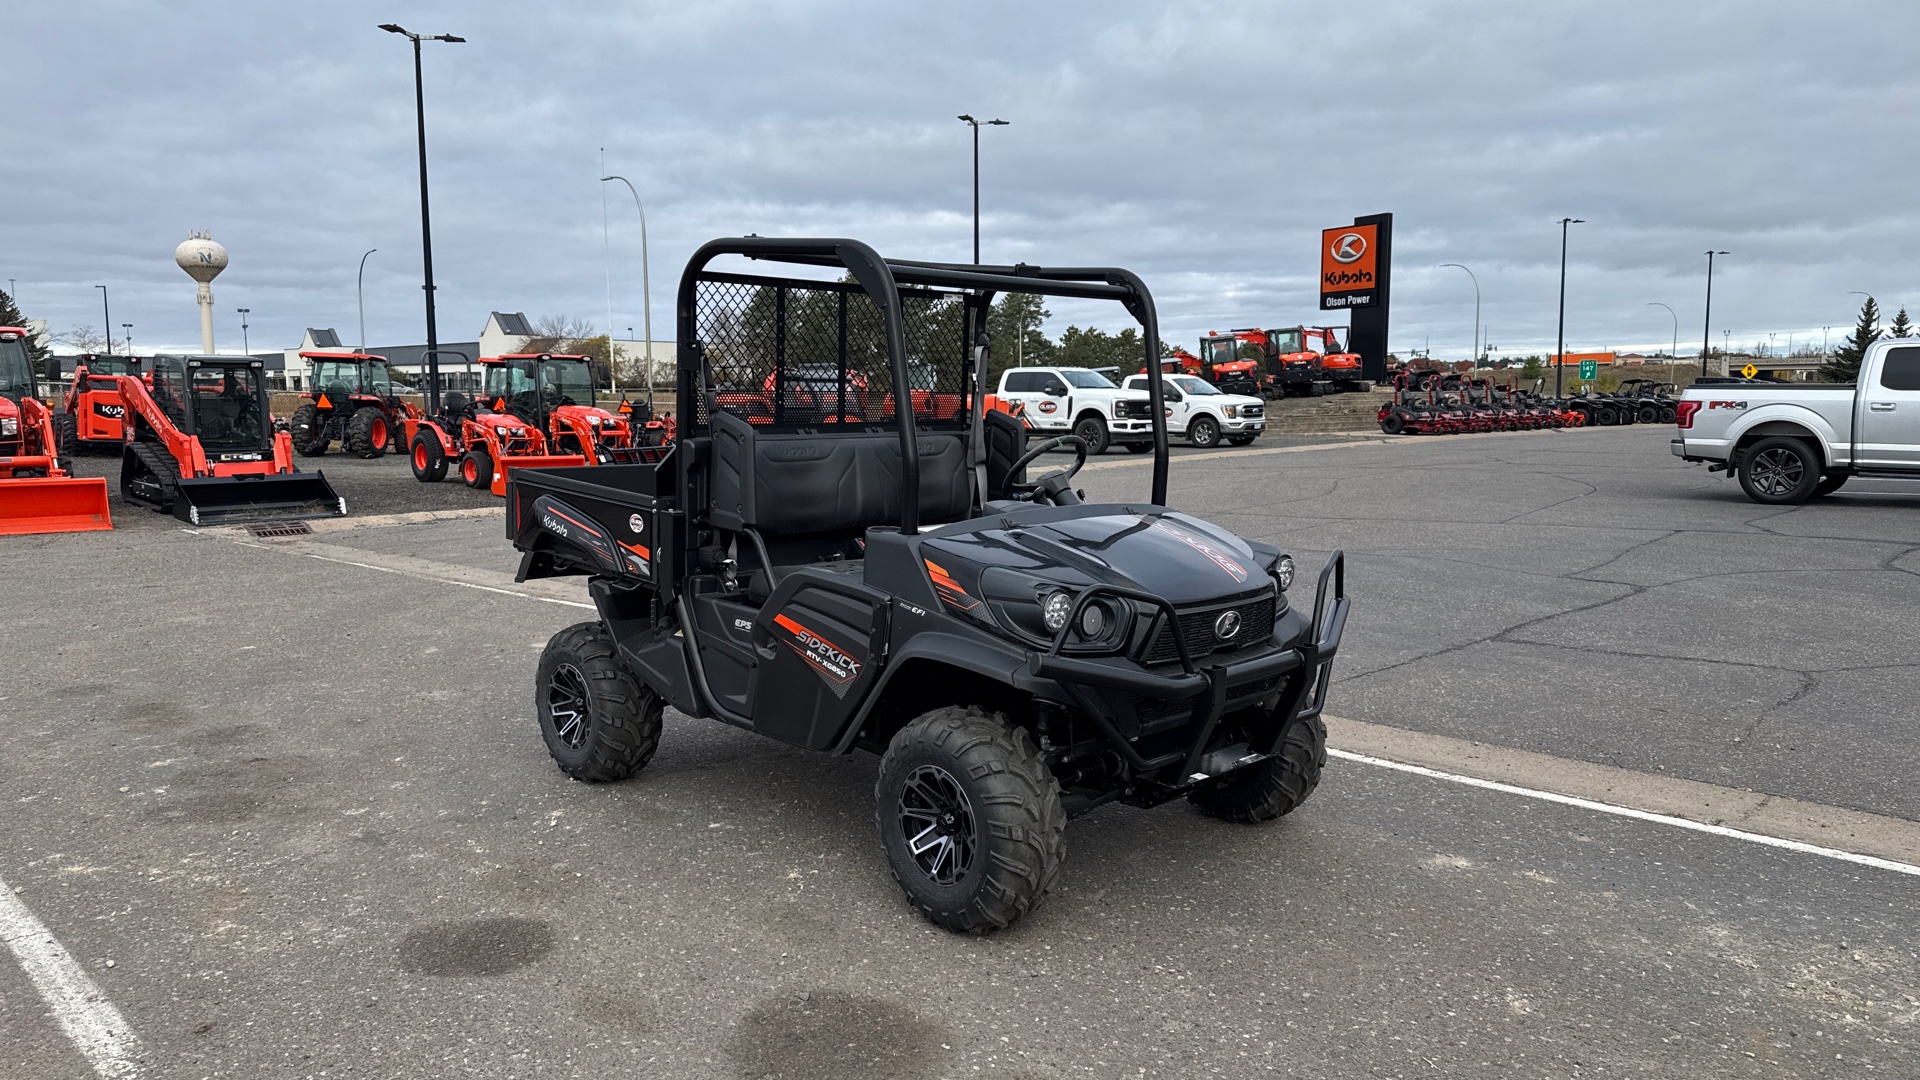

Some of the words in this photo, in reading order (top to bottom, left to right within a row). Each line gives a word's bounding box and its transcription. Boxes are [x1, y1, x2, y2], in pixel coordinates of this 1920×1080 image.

[1324, 268, 1373, 286] Kubota
[1326, 297, 1346, 307] Olson
[1347, 295, 1371, 305] Power
[102, 405, 125, 415] Kub
[1708, 400, 1748, 410] FX4
[543, 514, 568, 538] Kubota
[911, 606, 926, 617] EFI
[734, 618, 752, 630] EPS
[795, 630, 862, 675] SIDEKICK
[806, 650, 847, 678] RTV-XG850
